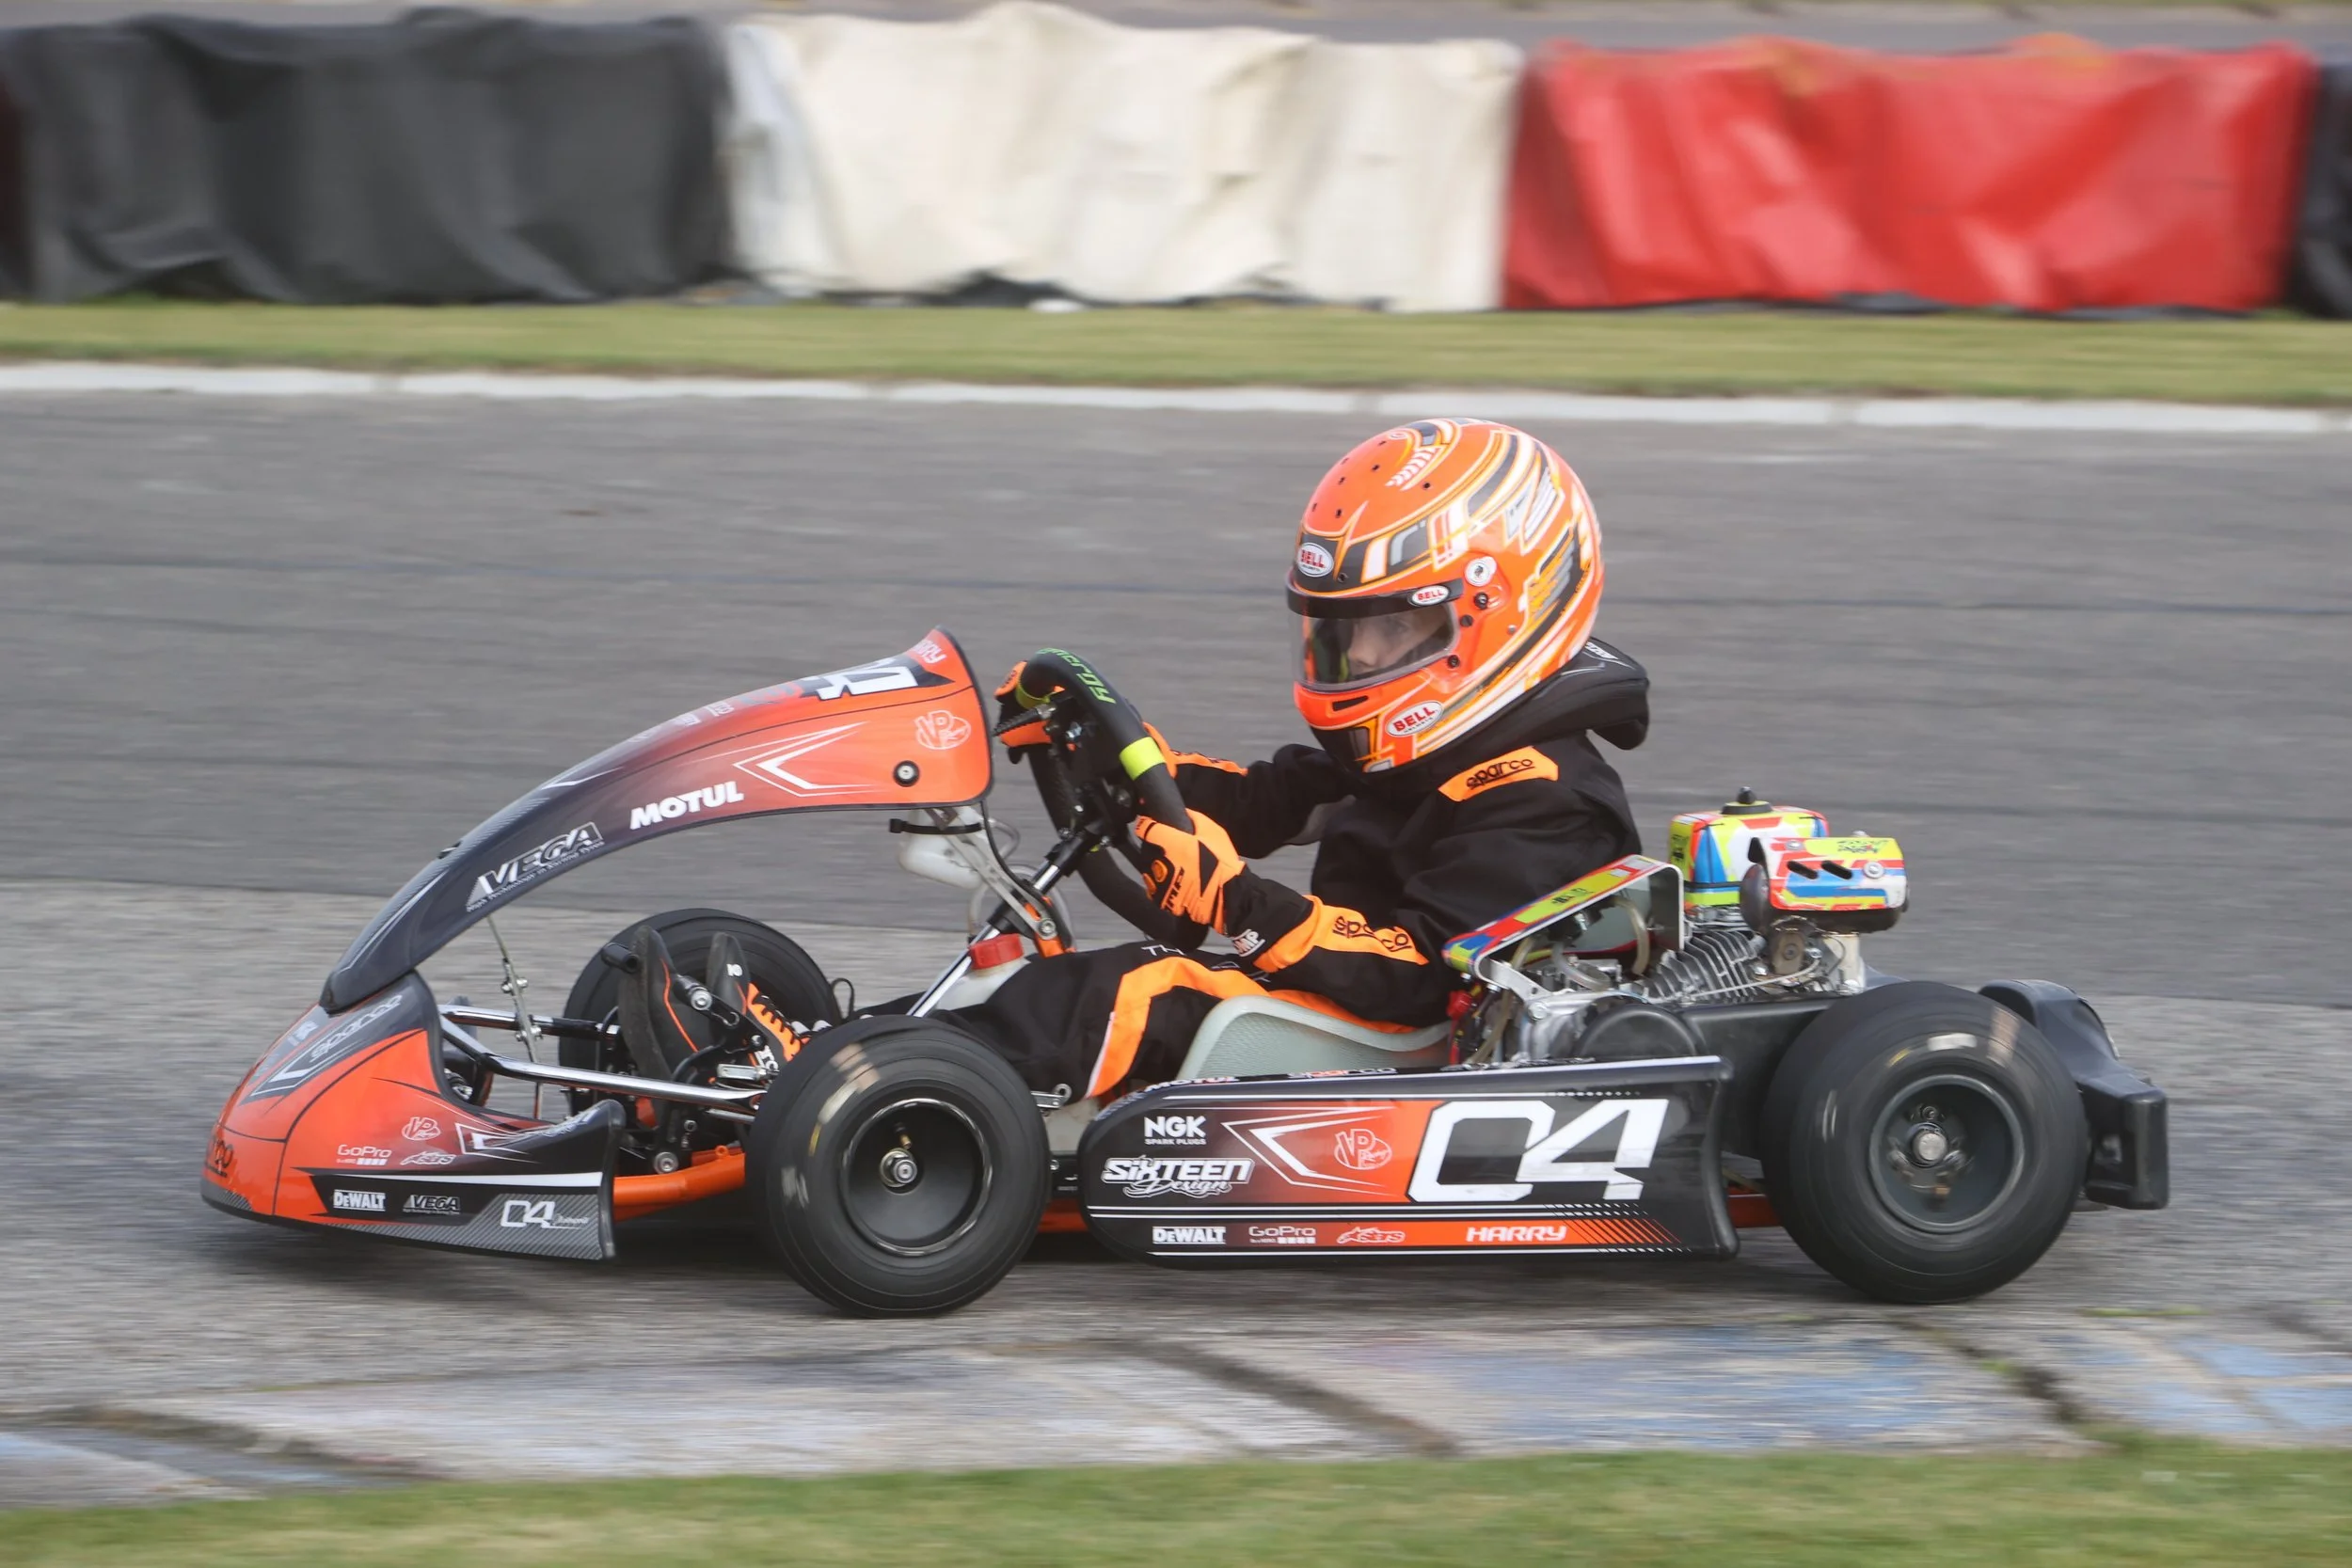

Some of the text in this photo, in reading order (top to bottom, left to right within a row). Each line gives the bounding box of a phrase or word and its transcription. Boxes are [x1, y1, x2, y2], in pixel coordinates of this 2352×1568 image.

[1301, 549, 1326, 568] BELL
[1418, 590, 1444, 600] BELL
[1393, 706, 1436, 732] BELL
[1467, 758, 1534, 789] sparco
[630, 781, 744, 830] MOTUL
[477, 822, 603, 894] VEGA
[1143, 1116, 1206, 1138] NGK
[337, 1144, 392, 1158] GoPro
[408, 1195, 460, 1211] VEGA
[1248, 1226, 1316, 1237] GoPro
[1466, 1227, 1567, 1242] HARRY
